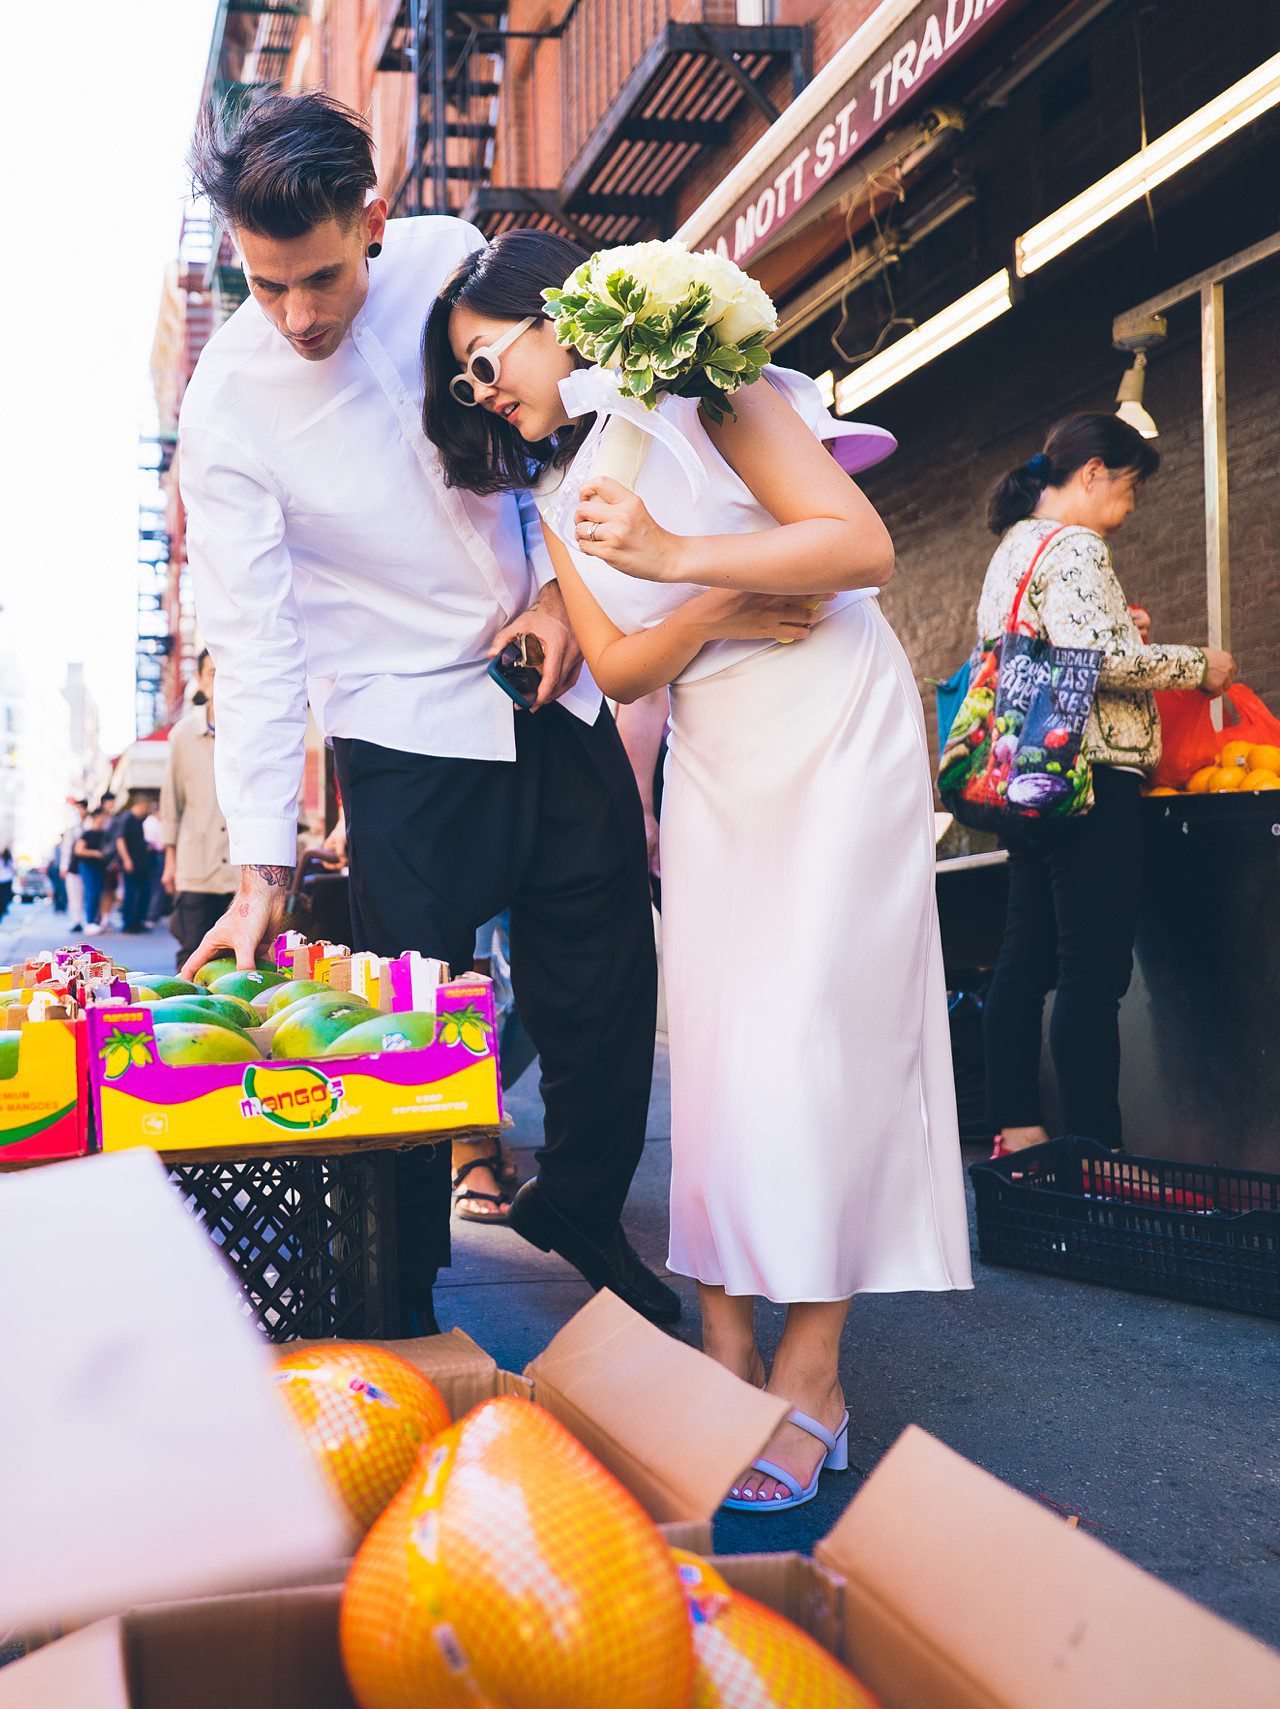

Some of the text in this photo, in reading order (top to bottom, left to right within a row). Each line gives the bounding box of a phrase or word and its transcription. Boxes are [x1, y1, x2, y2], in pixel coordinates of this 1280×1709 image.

[733, 146, 810, 261] MOTT
[814, 98, 859, 178] ST.
[870, 0, 996, 122] TRAD
[6, 1101, 59, 1112] MANGOES
